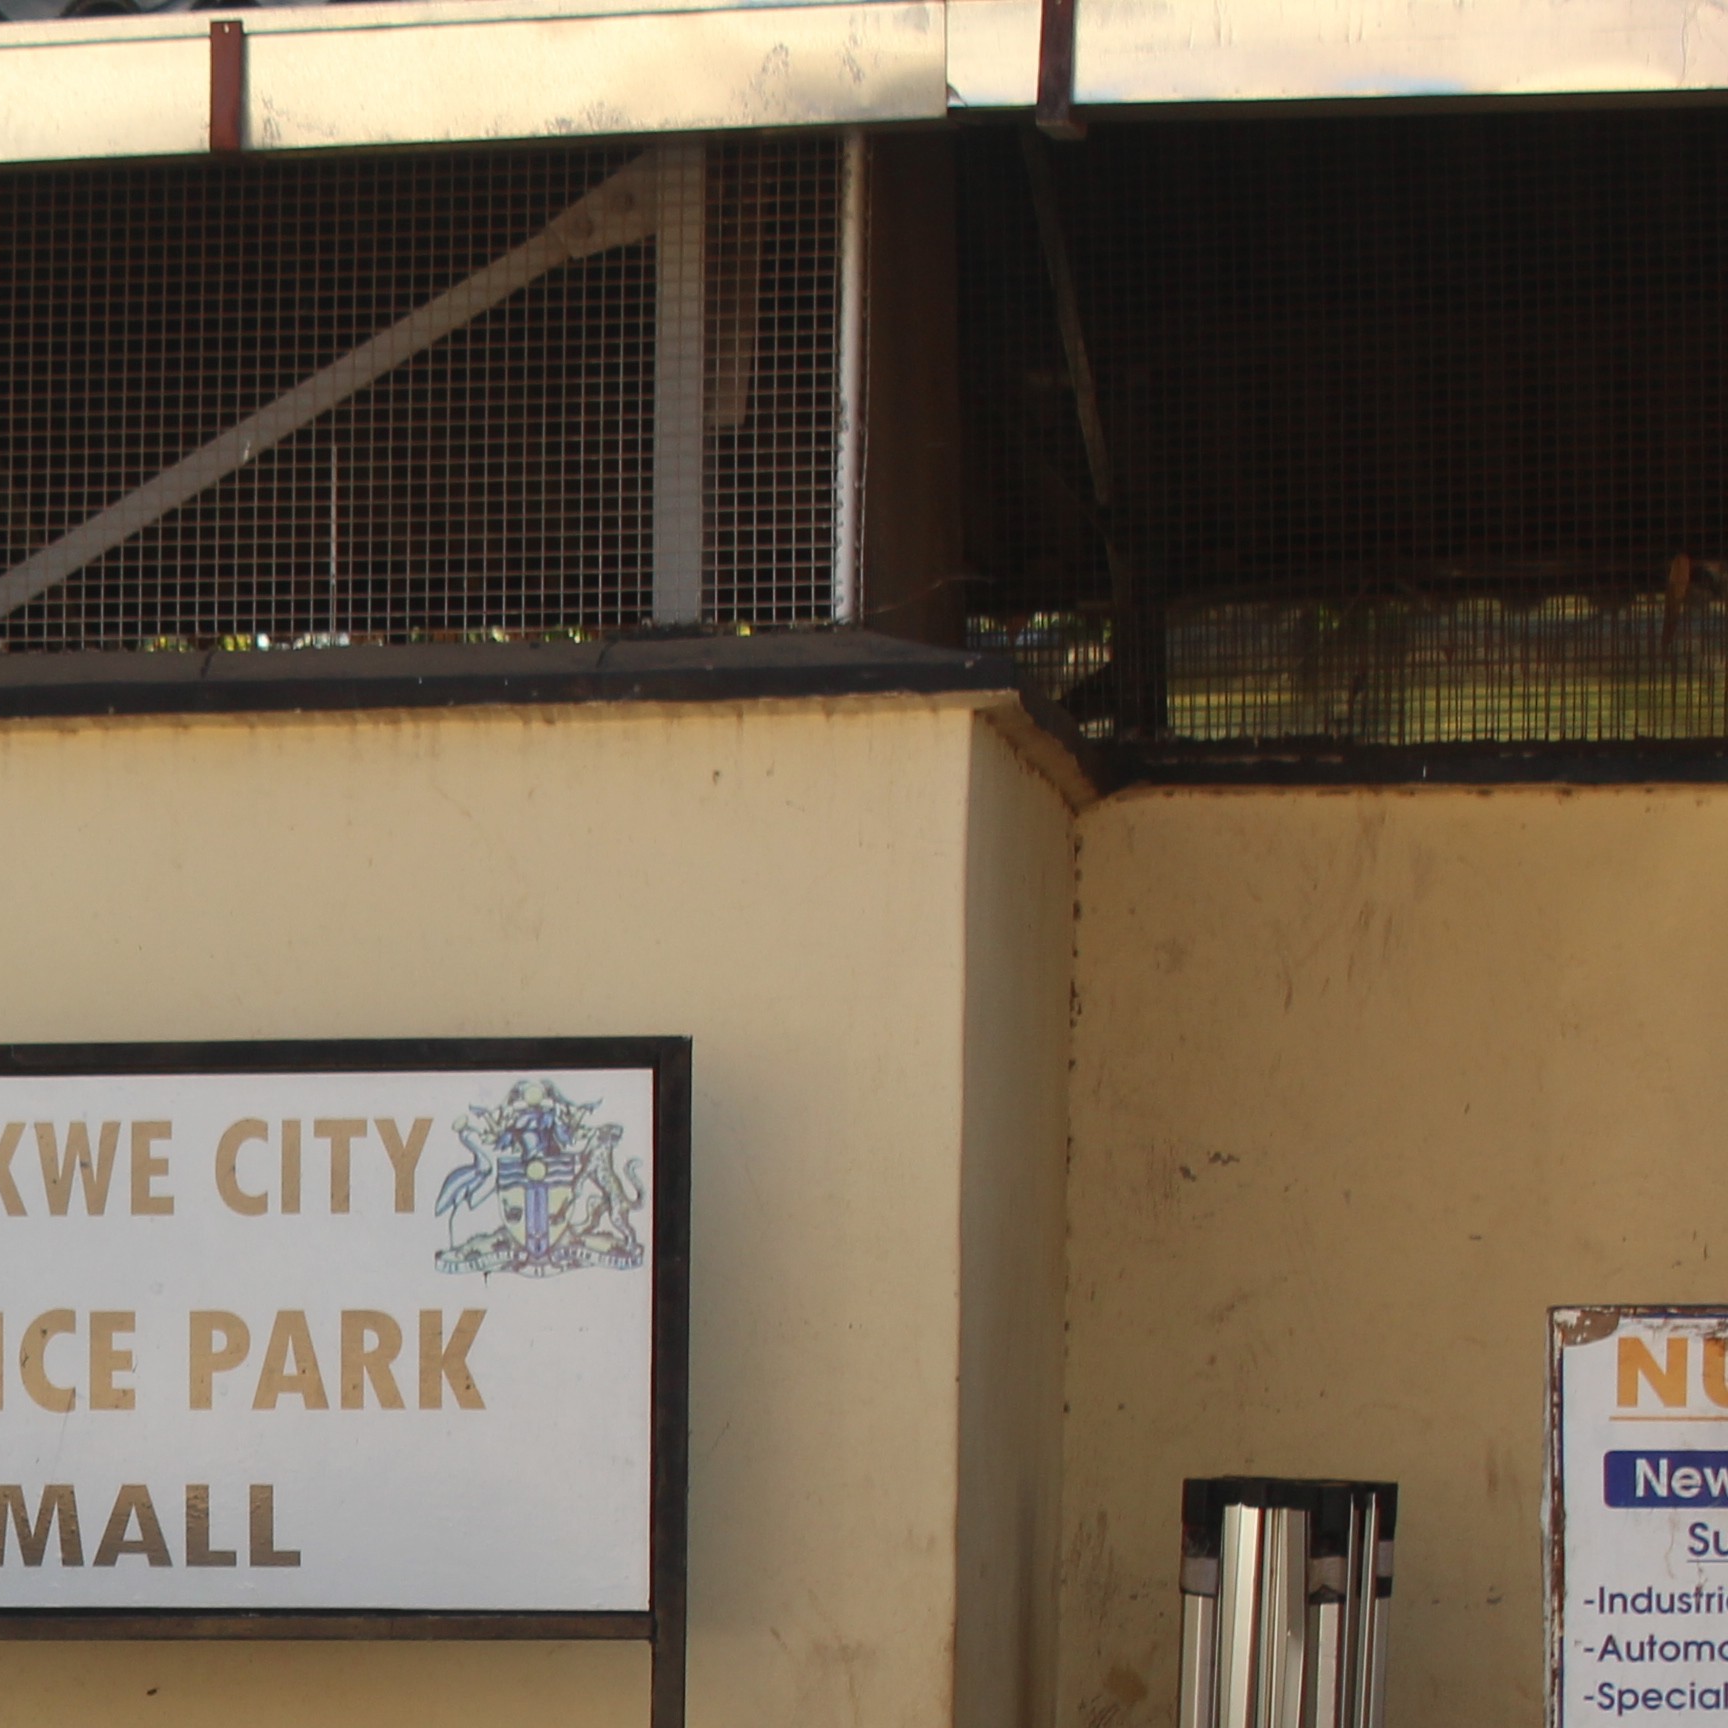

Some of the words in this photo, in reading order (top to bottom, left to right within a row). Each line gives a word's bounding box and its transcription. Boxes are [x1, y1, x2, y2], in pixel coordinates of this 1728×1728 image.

[215, 1116, 435, 1216] CITY
[187, 1307, 488, 1412] PARK
[1583, 1585, 1728, 1615] -Industri
